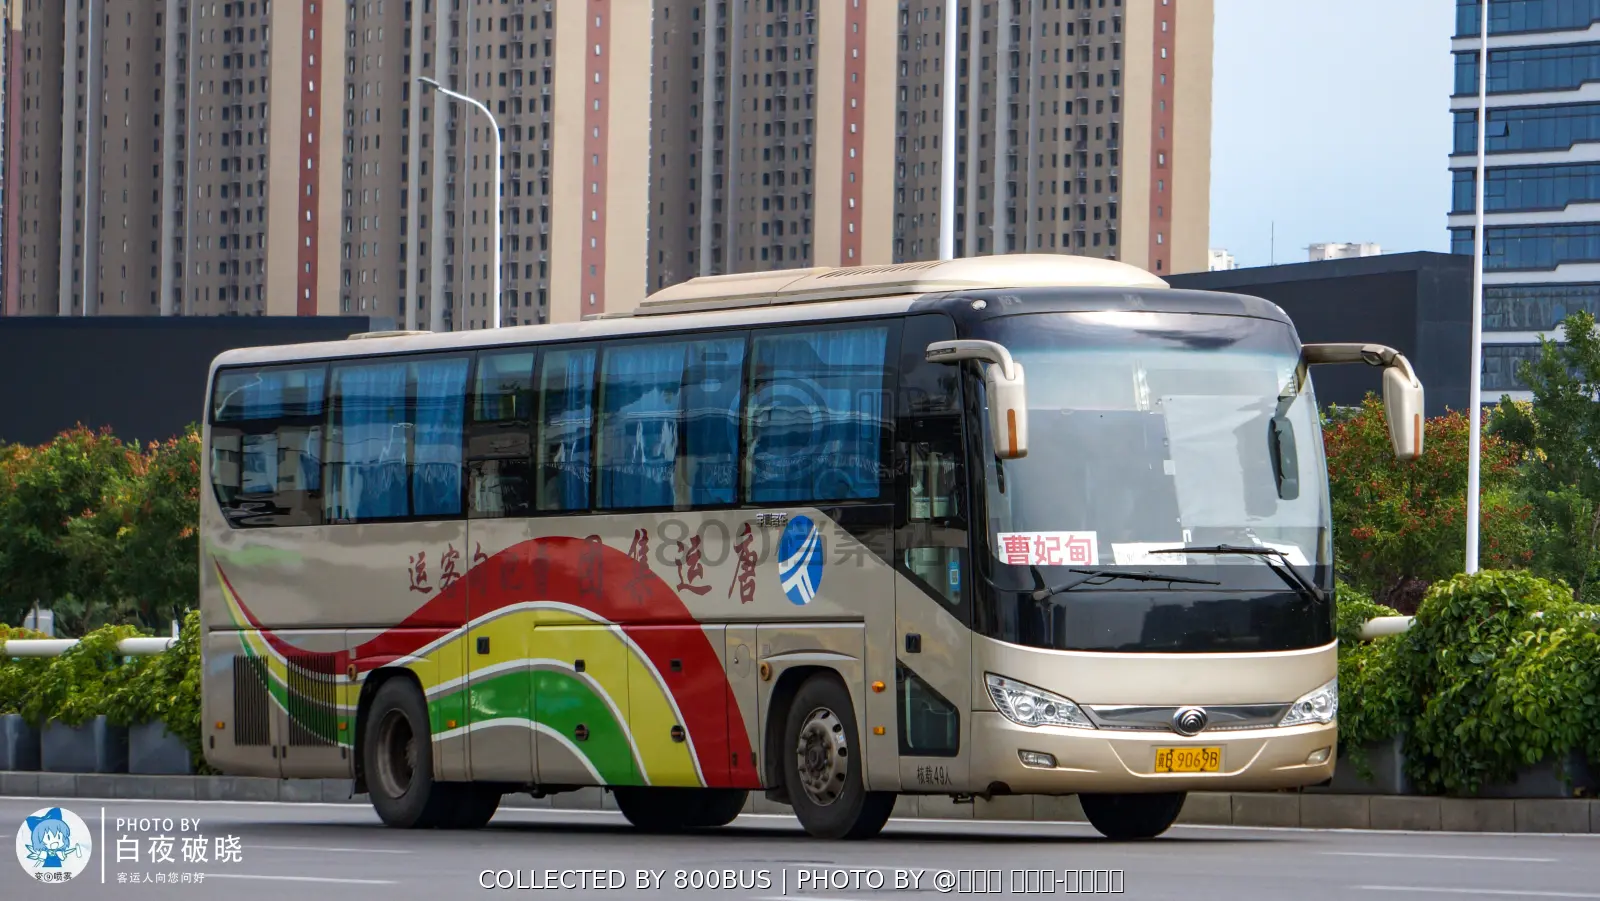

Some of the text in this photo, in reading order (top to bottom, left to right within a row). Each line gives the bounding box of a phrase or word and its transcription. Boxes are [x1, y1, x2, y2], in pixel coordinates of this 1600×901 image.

[1002, 534, 1092, 566] 曹妃甸
[917, 765, 952, 785] 核载49人
